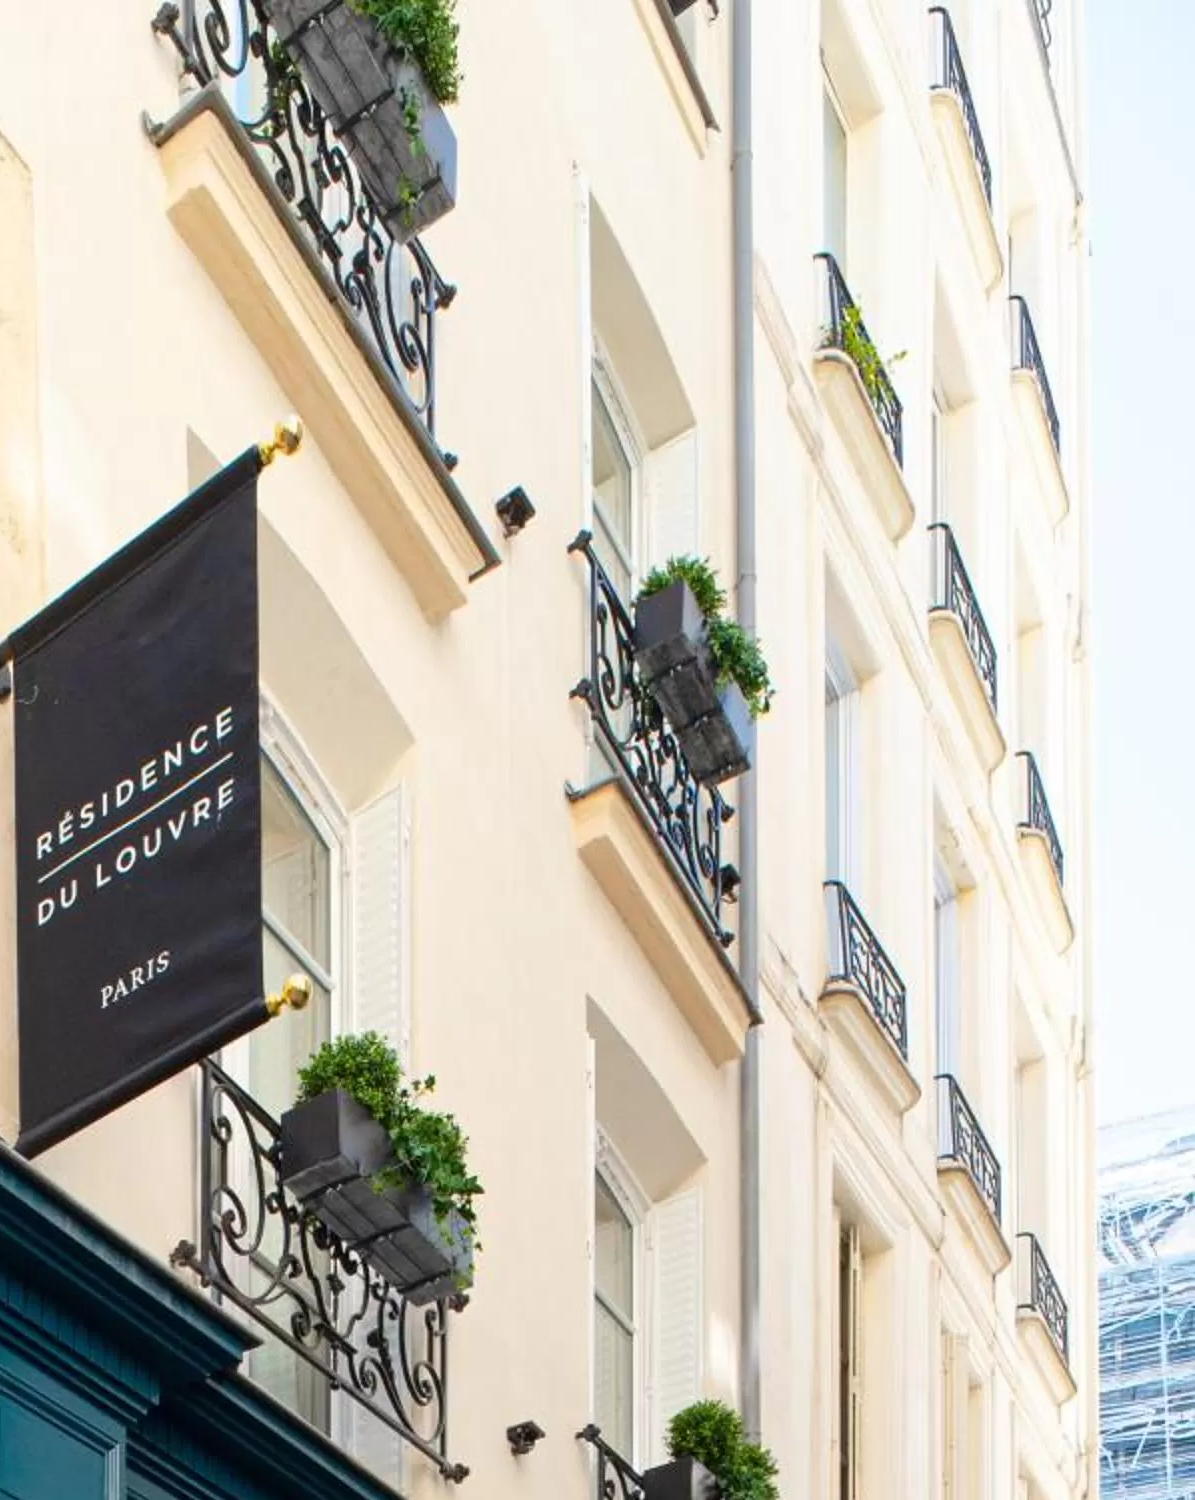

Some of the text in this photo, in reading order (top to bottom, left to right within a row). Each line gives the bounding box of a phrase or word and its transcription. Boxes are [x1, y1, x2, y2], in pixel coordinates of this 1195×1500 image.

[35, 706, 234, 860] RÉSIDENCE
[36, 778, 236, 926] DU LOUVRE
[100, 950, 171, 1010] PARIS
